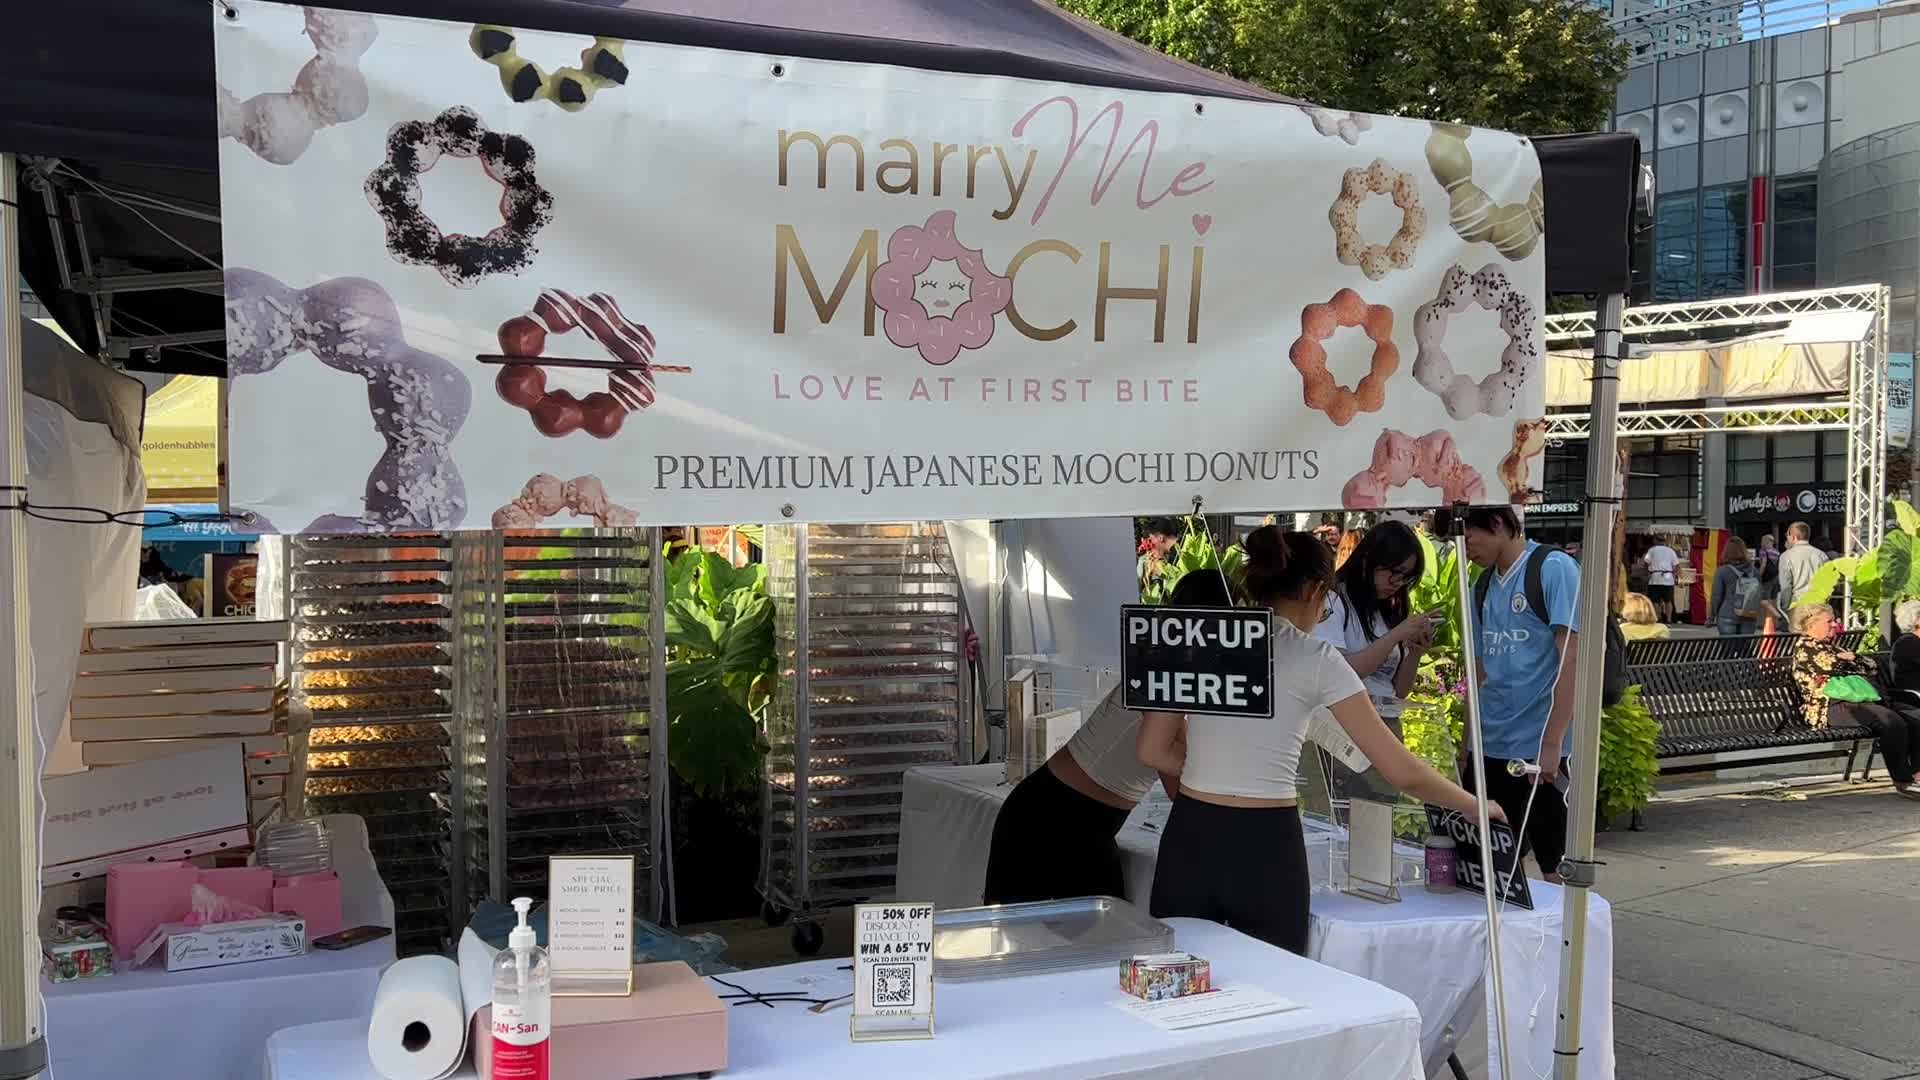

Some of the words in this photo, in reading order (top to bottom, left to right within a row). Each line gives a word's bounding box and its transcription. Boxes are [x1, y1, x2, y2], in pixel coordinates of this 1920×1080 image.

[777, 128, 1038, 221] marry
[1011, 95, 1216, 226] Me
[773, 373, 883, 402] LOVE
[908, 376, 955, 402] AT
[981, 377, 1093, 402] FIRST
[1116, 378, 1200, 403] BITE
[653, 454, 855, 490] PREMIUM
[860, 453, 1043, 495] JAPANESE
[1052, 452, 1176, 486] MOCHI
[1183, 449, 1320, 482] DONUTS
[1542, 503, 1579, 512] EMPRESS
[1728, 492, 1773, 514] Wendy's
[1129, 617, 1266, 649] PICK-UP
[1147, 670, 1248, 706] HERE
[882, 908, 905, 920] 50%
[910, 907, 931, 919] OFF
[865, 921, 914, 931] DISCOUNT
[861, 943, 880, 954] WIN
[884, 943, 892, 954] A
[916, 942, 931, 953] TV
[494, 1022, 539, 1034] AN-San
